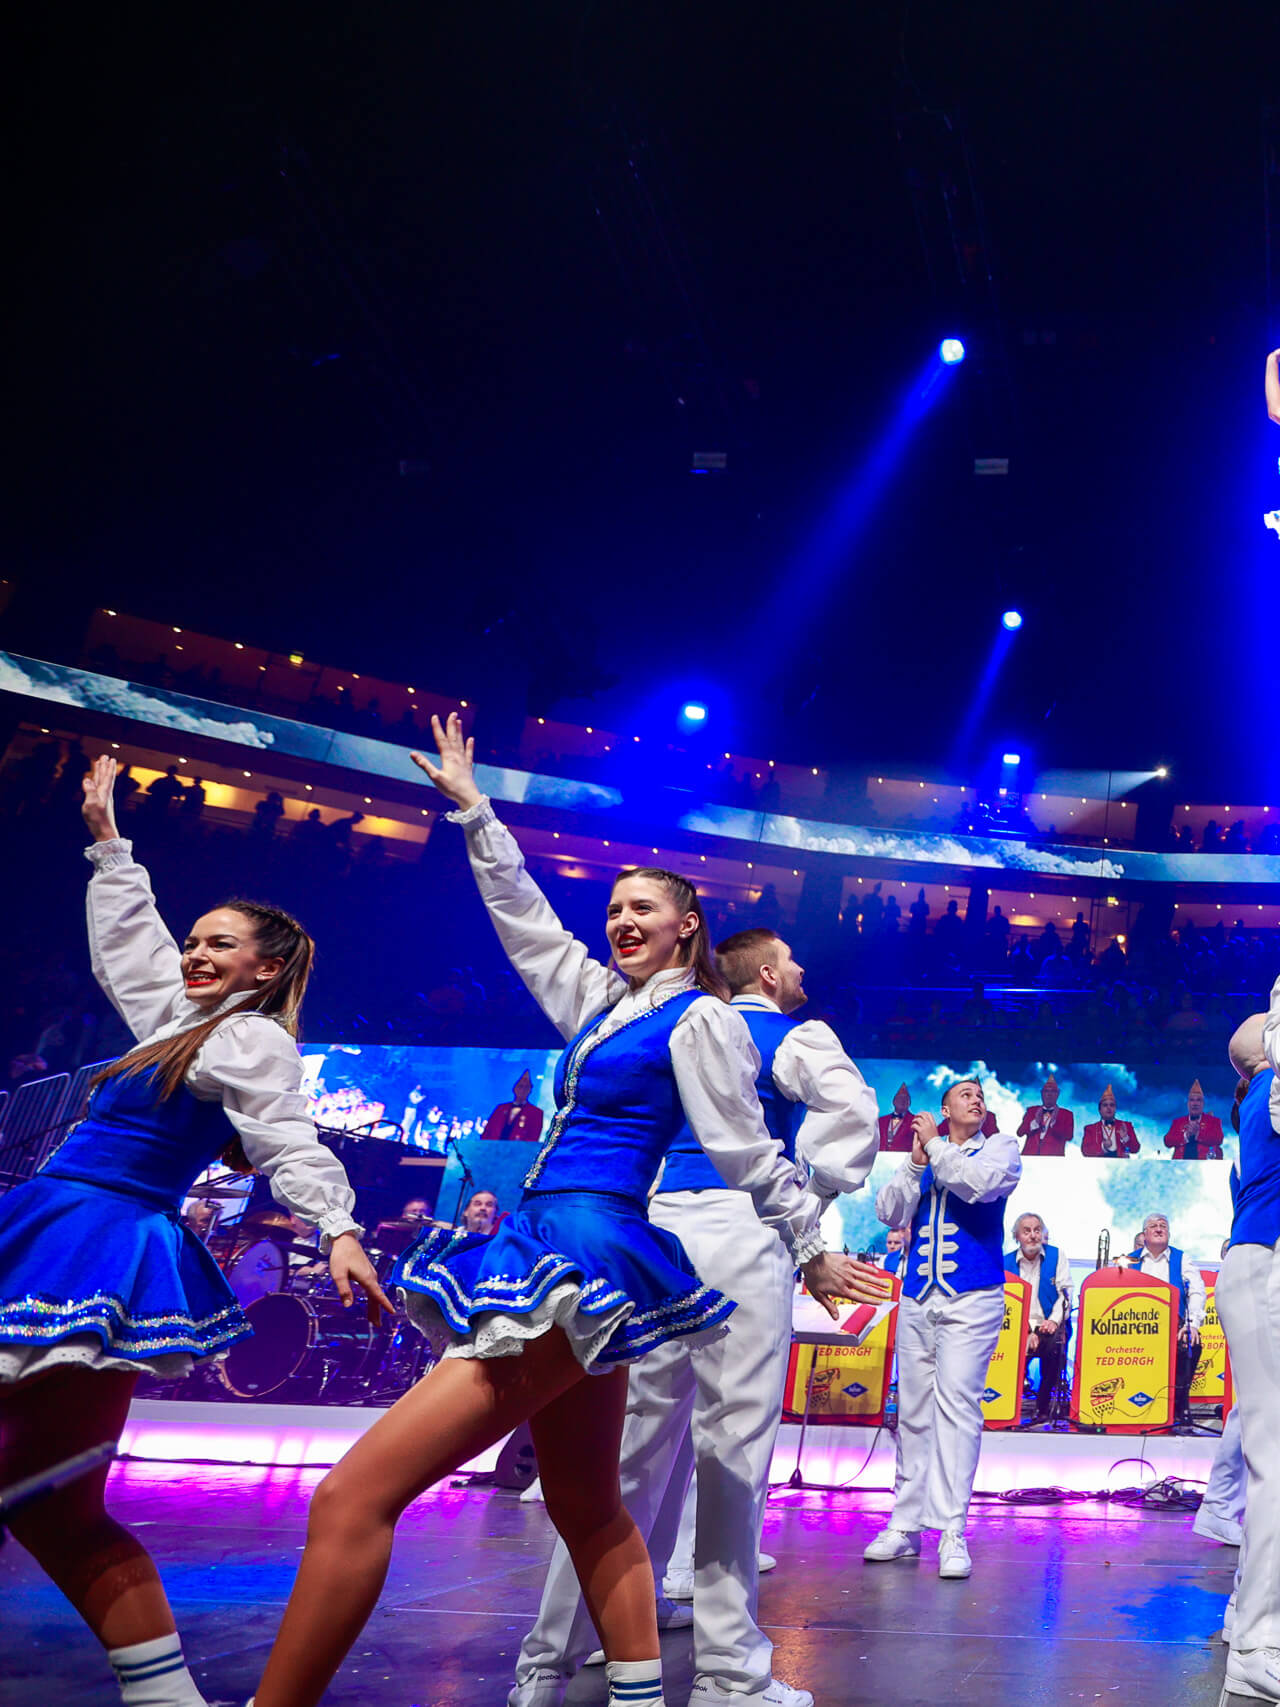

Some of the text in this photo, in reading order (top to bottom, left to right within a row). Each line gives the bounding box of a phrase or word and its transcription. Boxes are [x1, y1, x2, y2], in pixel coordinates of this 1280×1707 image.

[1111, 1308, 1160, 1321] Lachende
[818, 1347, 872, 1357] ED BORGH
[1105, 1345, 1145, 1354] Orchester
[1096, 1356, 1155, 1366] TED BORGH
